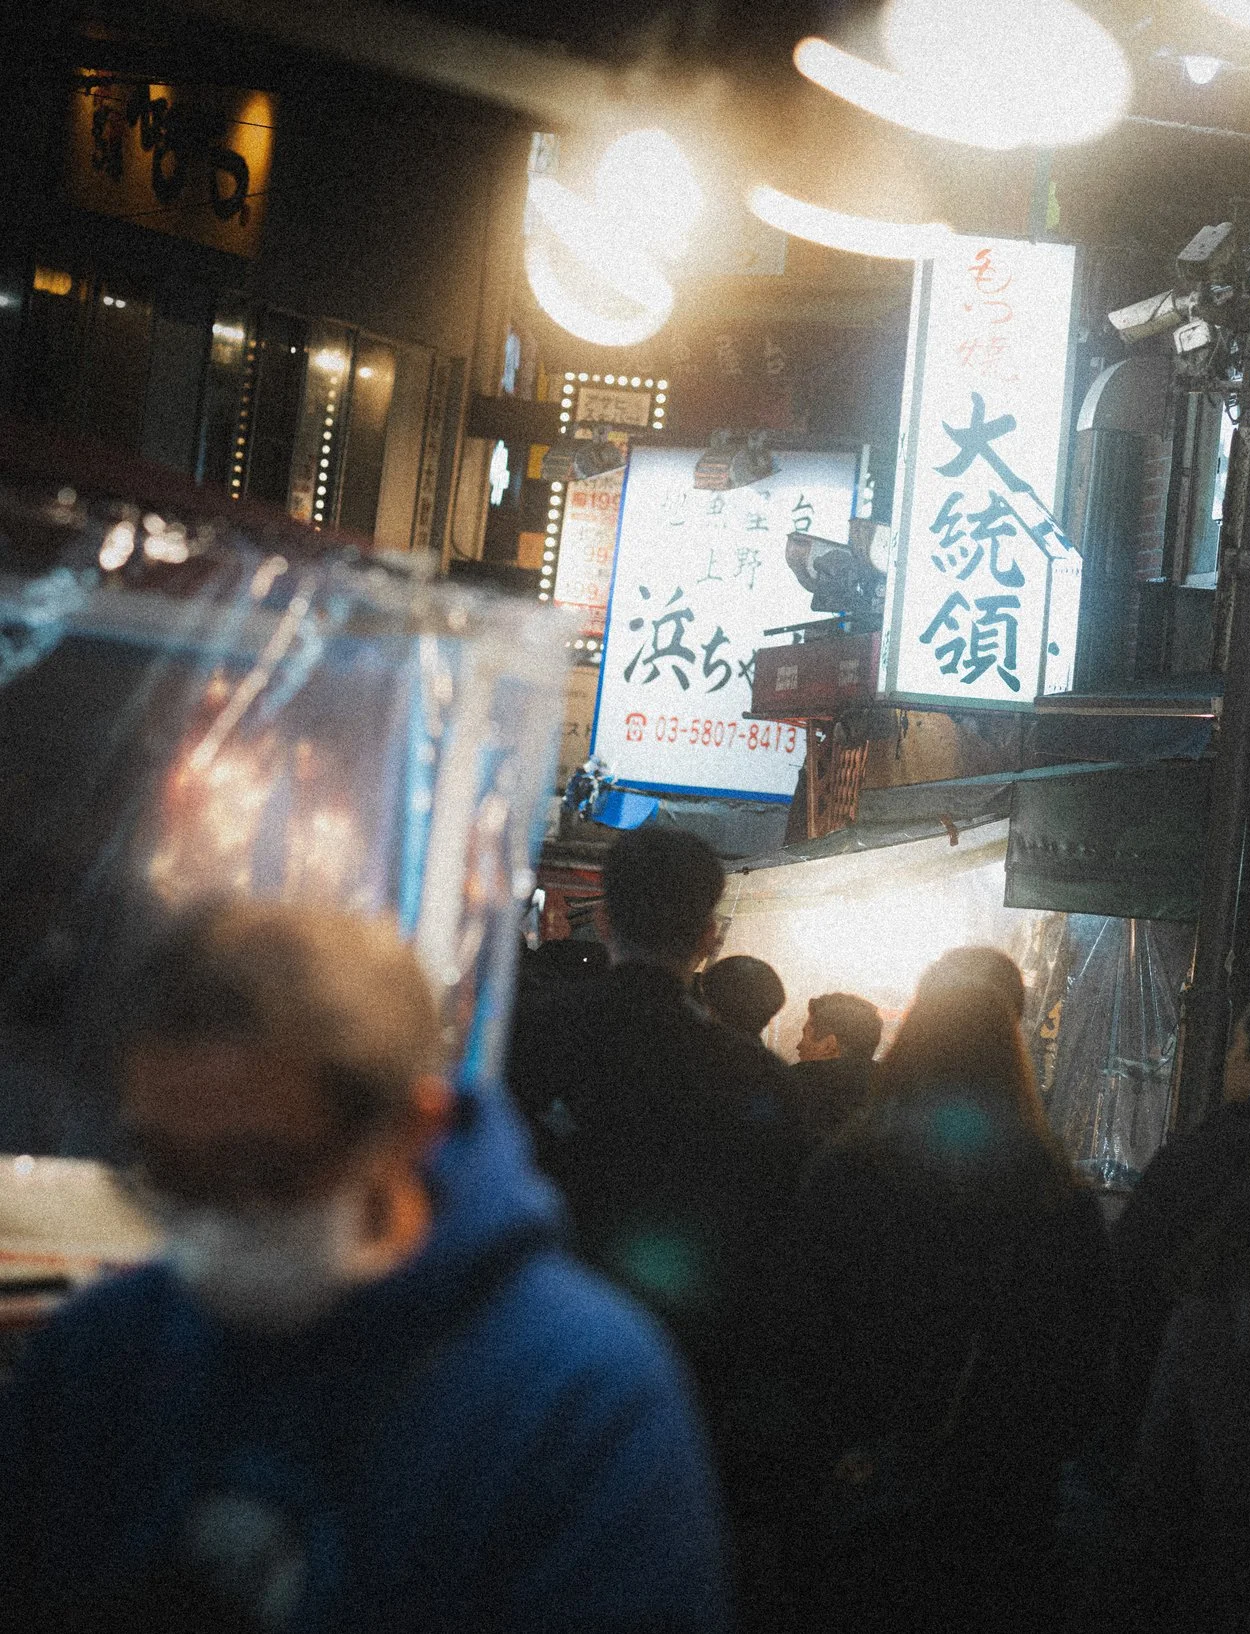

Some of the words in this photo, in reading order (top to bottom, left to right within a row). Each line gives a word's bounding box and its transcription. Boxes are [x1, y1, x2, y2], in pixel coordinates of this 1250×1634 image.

[919, 391, 1031, 693] 大統領
[697, 548, 762, 590] 上野
[655, 715, 798, 753] 03-5807-8413
